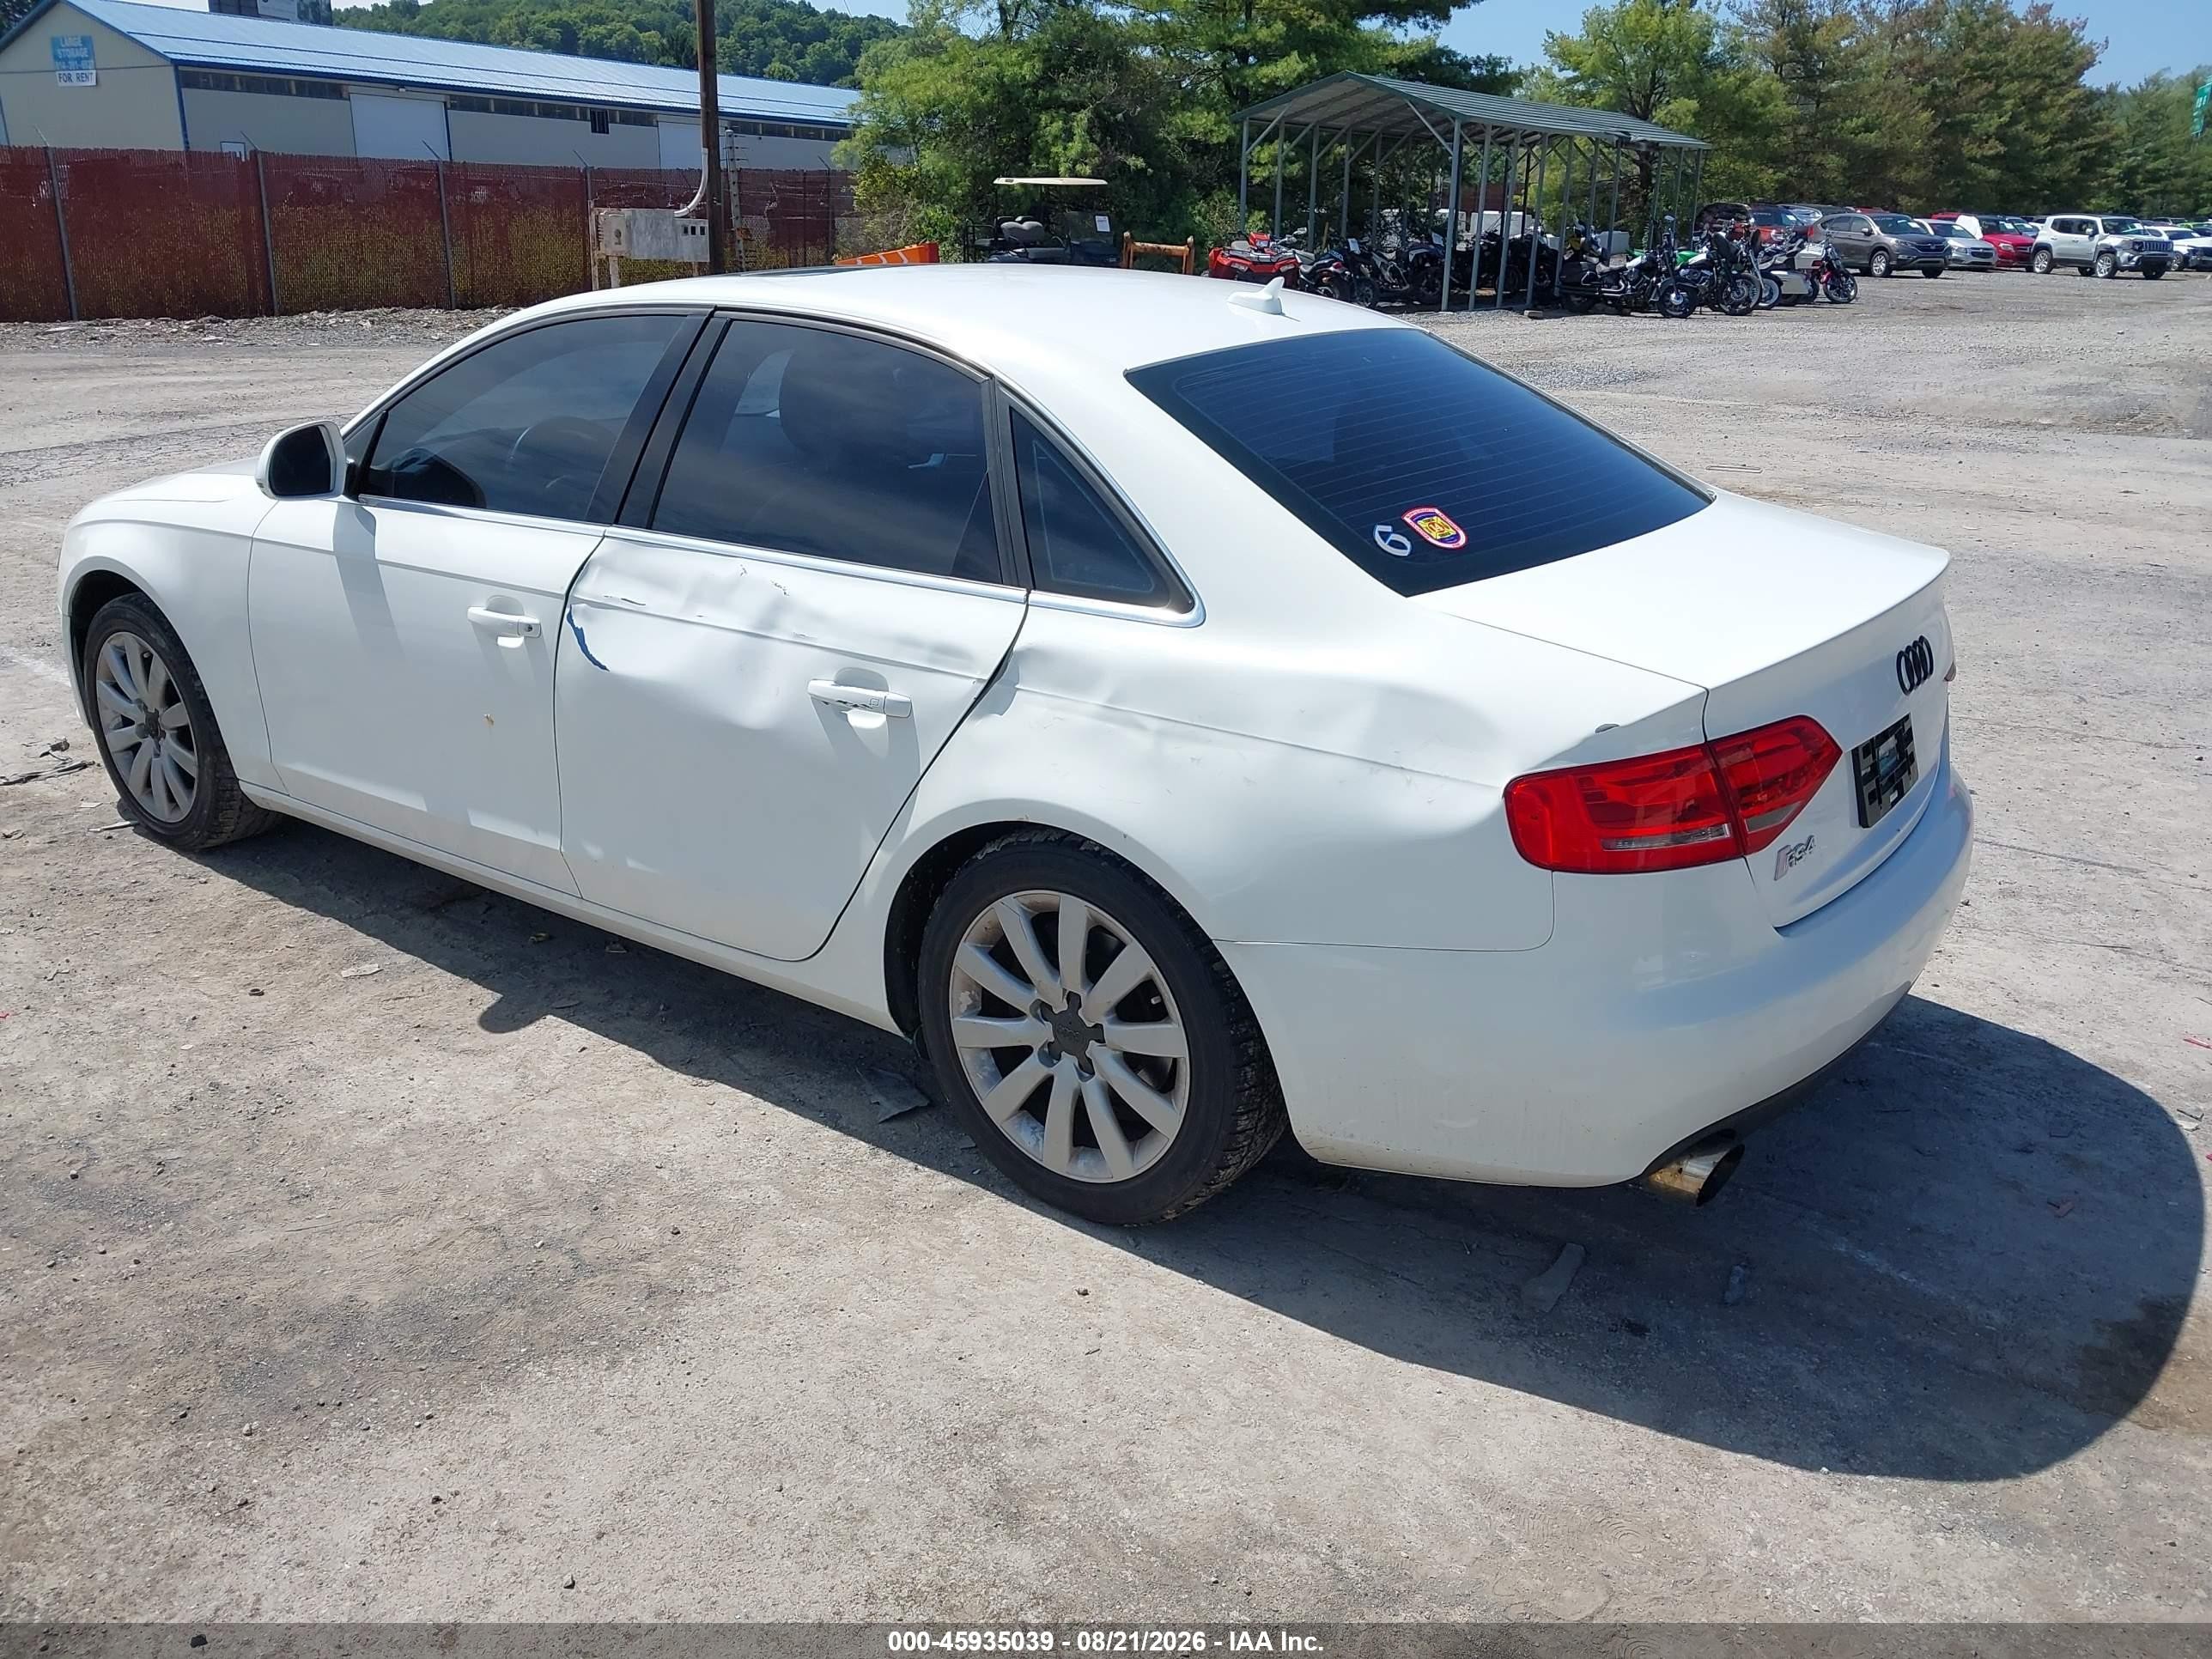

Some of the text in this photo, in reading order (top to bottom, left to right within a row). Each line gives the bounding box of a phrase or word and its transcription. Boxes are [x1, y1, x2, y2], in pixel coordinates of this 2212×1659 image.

[58, 72, 94, 83] FOR RENT
[1373, 525, 1411, 556] 6
